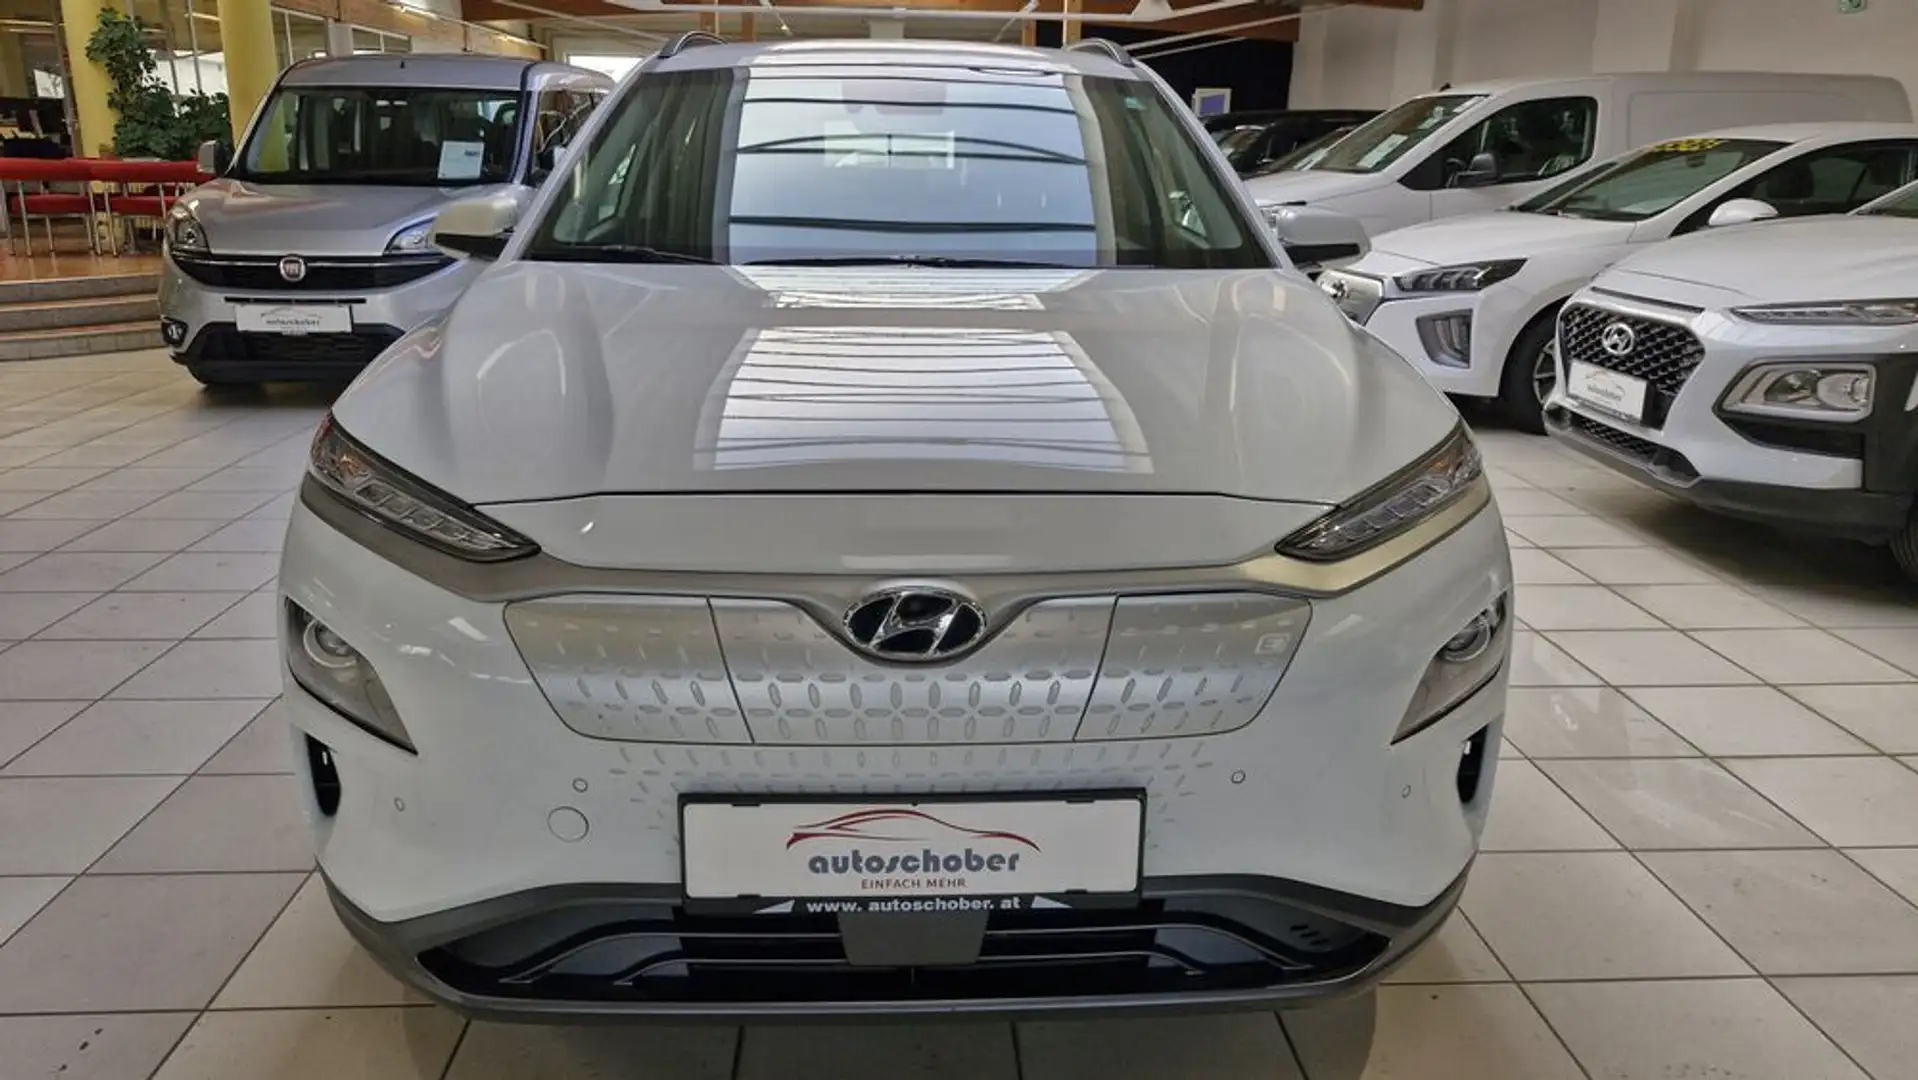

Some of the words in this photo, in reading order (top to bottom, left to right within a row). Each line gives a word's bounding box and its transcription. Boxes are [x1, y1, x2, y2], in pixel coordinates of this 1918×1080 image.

[808, 848, 1020, 874] autoschober
[861, 878, 921, 890] EINFACH
[926, 877, 968, 889] MEHR
